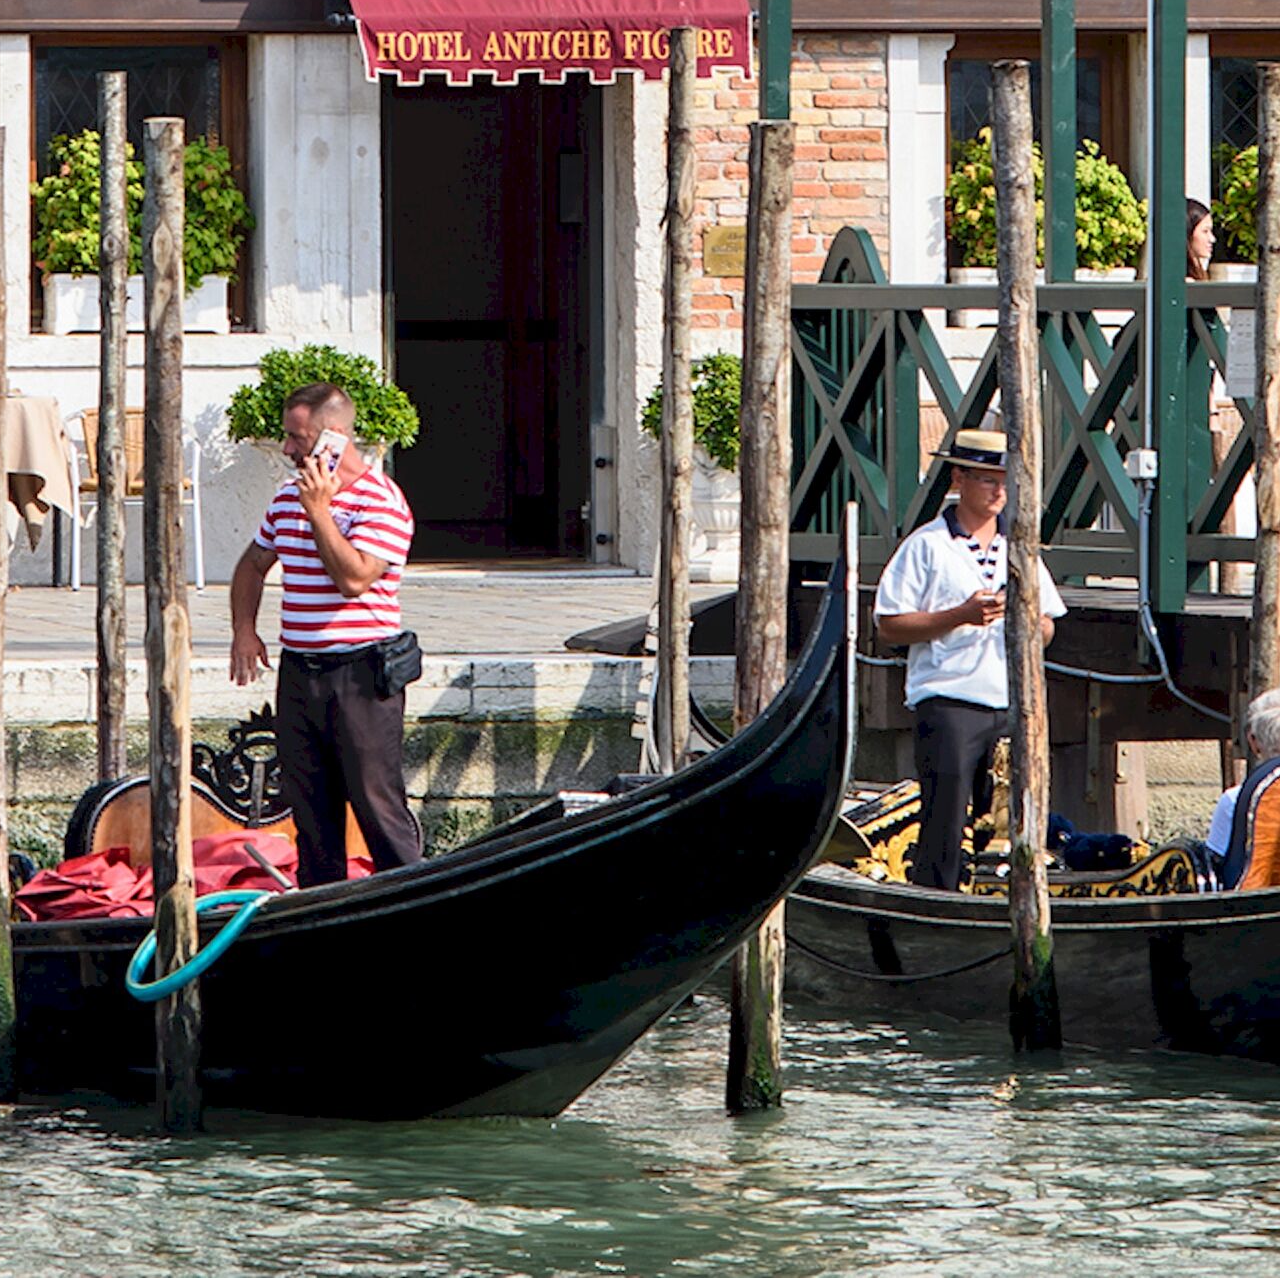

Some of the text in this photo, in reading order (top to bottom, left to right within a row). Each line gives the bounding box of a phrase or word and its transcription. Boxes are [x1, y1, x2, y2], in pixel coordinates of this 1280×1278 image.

[377, 28, 734, 61] HOTEL ANTICHE FIGRE
